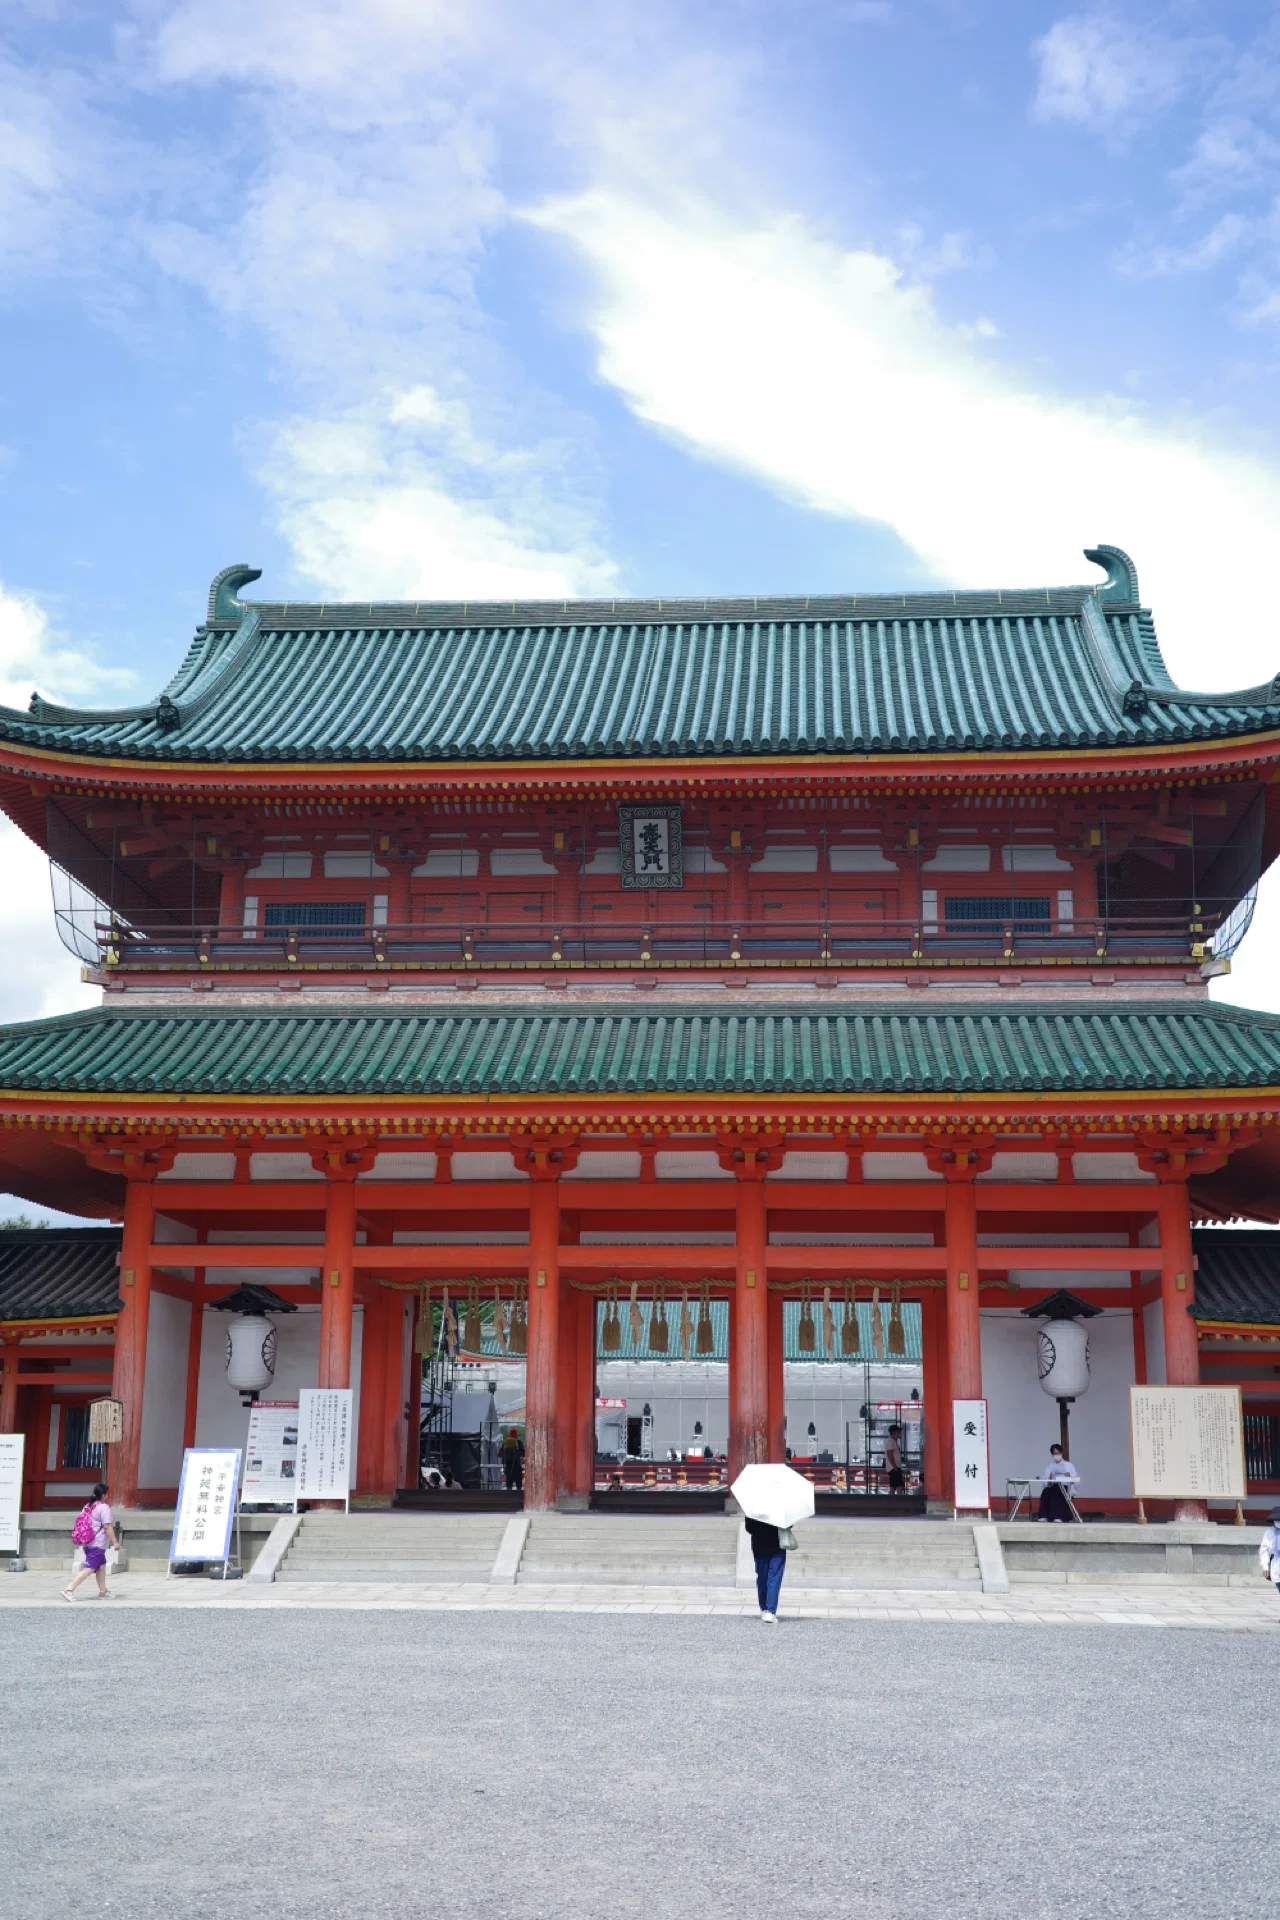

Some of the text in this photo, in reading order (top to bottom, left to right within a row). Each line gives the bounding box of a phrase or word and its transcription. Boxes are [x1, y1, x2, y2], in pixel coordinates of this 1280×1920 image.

[963, 1421, 979, 1479] 受付
[192, 1466, 213, 1541] 神苑無料公開
[213, 1472, 227, 1515] 平安神宮
